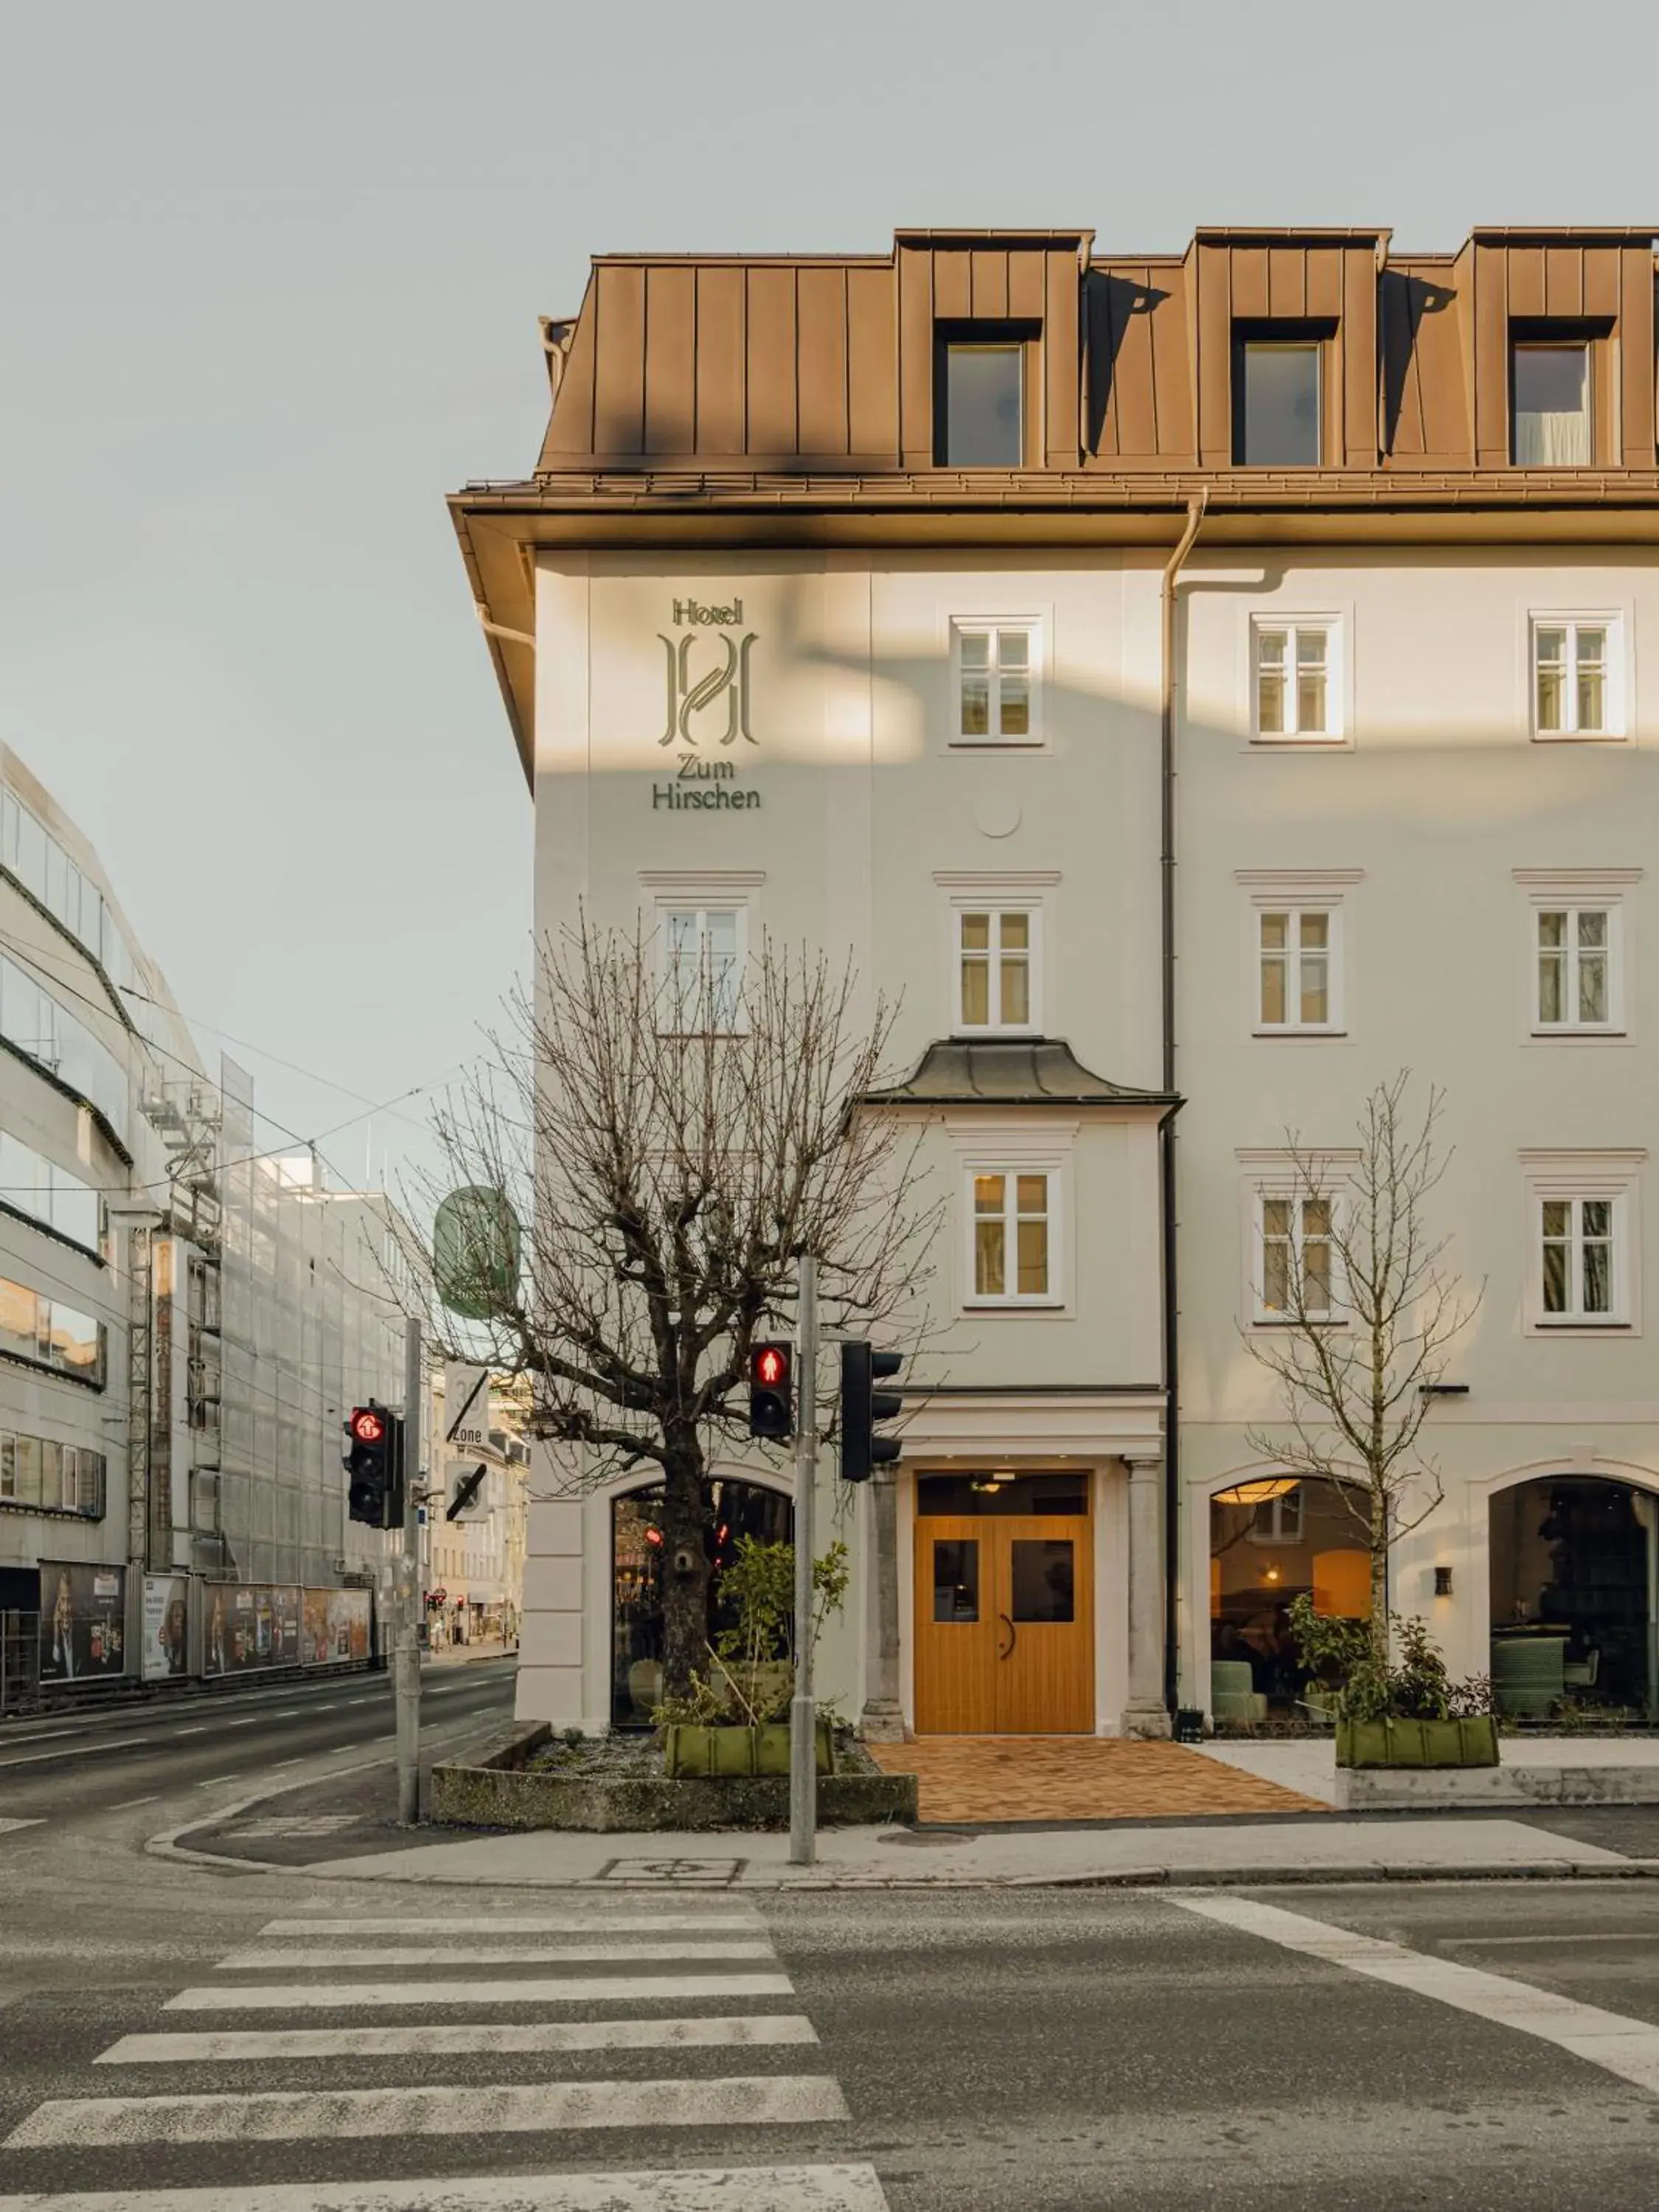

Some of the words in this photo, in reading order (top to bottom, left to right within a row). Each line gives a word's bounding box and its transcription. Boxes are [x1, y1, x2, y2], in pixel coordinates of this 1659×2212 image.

[672, 597, 743, 625] Hotel
[676, 752, 734, 780] Zum
[652, 782, 761, 810] Hirschen
